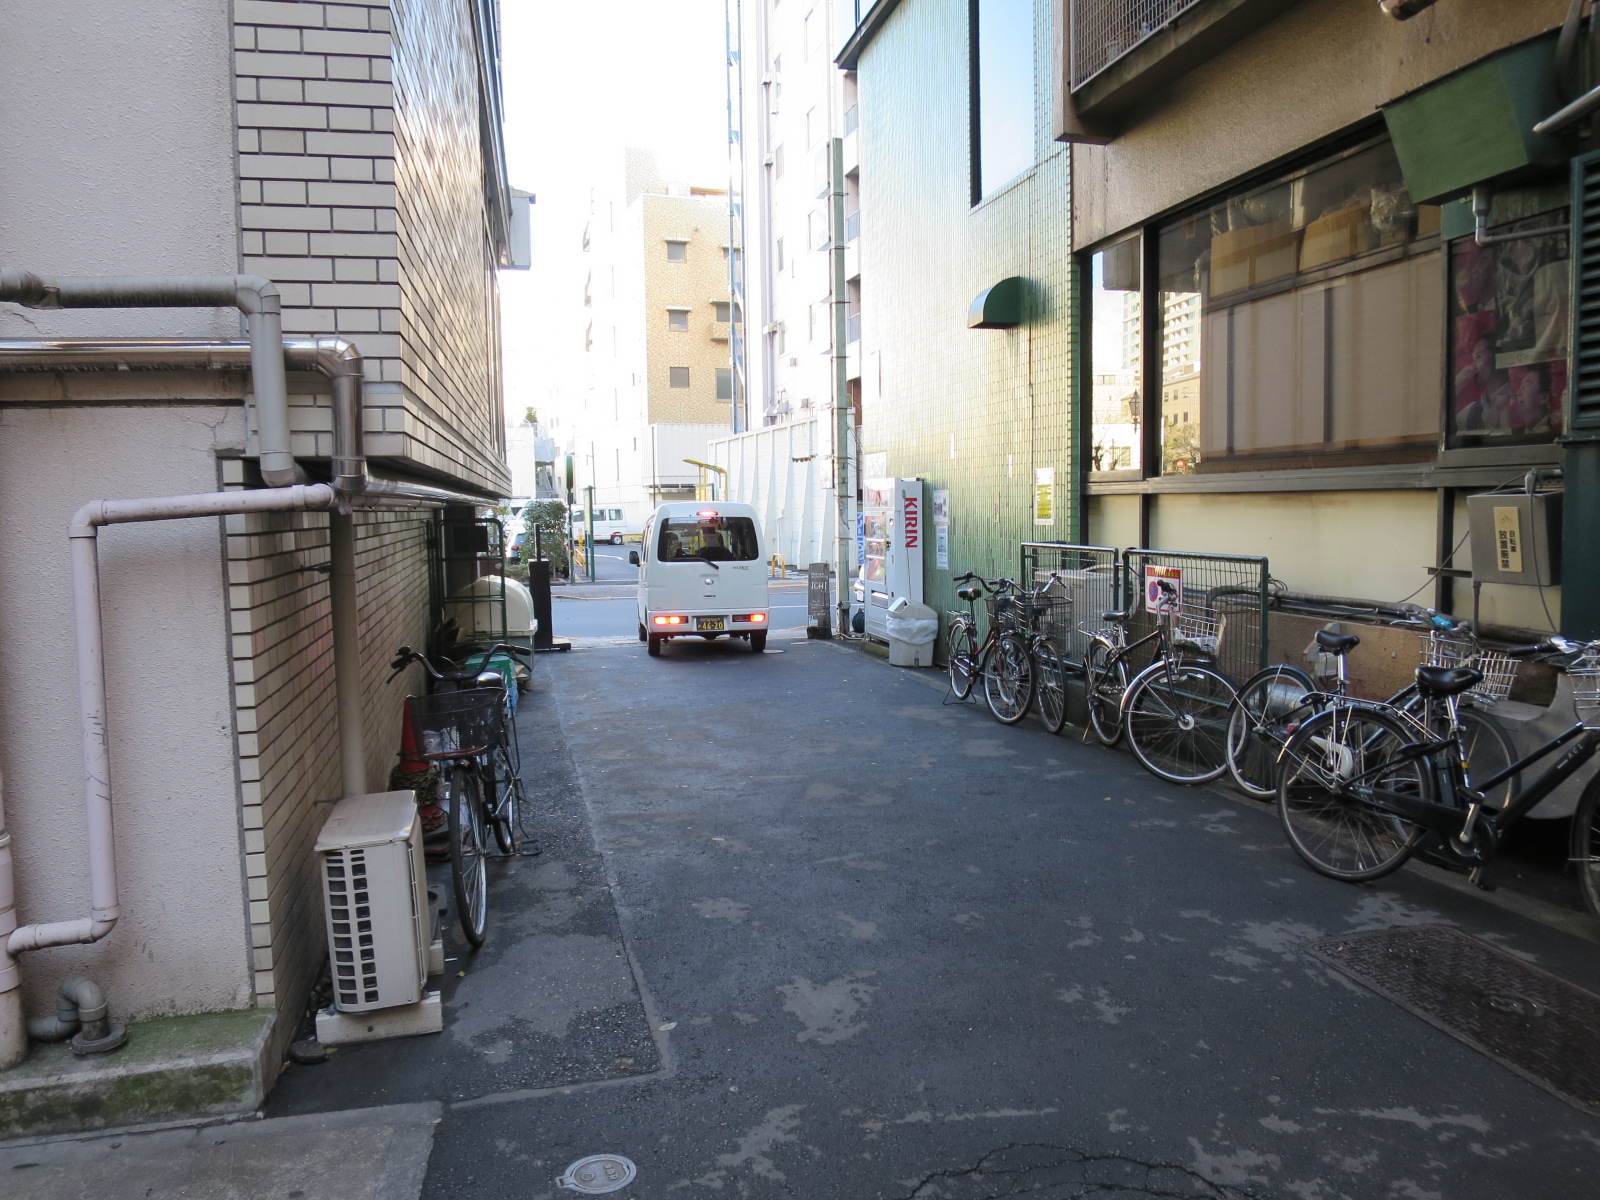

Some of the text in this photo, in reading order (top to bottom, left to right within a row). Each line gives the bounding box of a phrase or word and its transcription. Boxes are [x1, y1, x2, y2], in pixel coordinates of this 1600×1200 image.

[905, 498, 917, 548] KIRIN
[1499, 530, 1510, 569] 放置厳禁
[811, 582, 827, 590] ICHI
